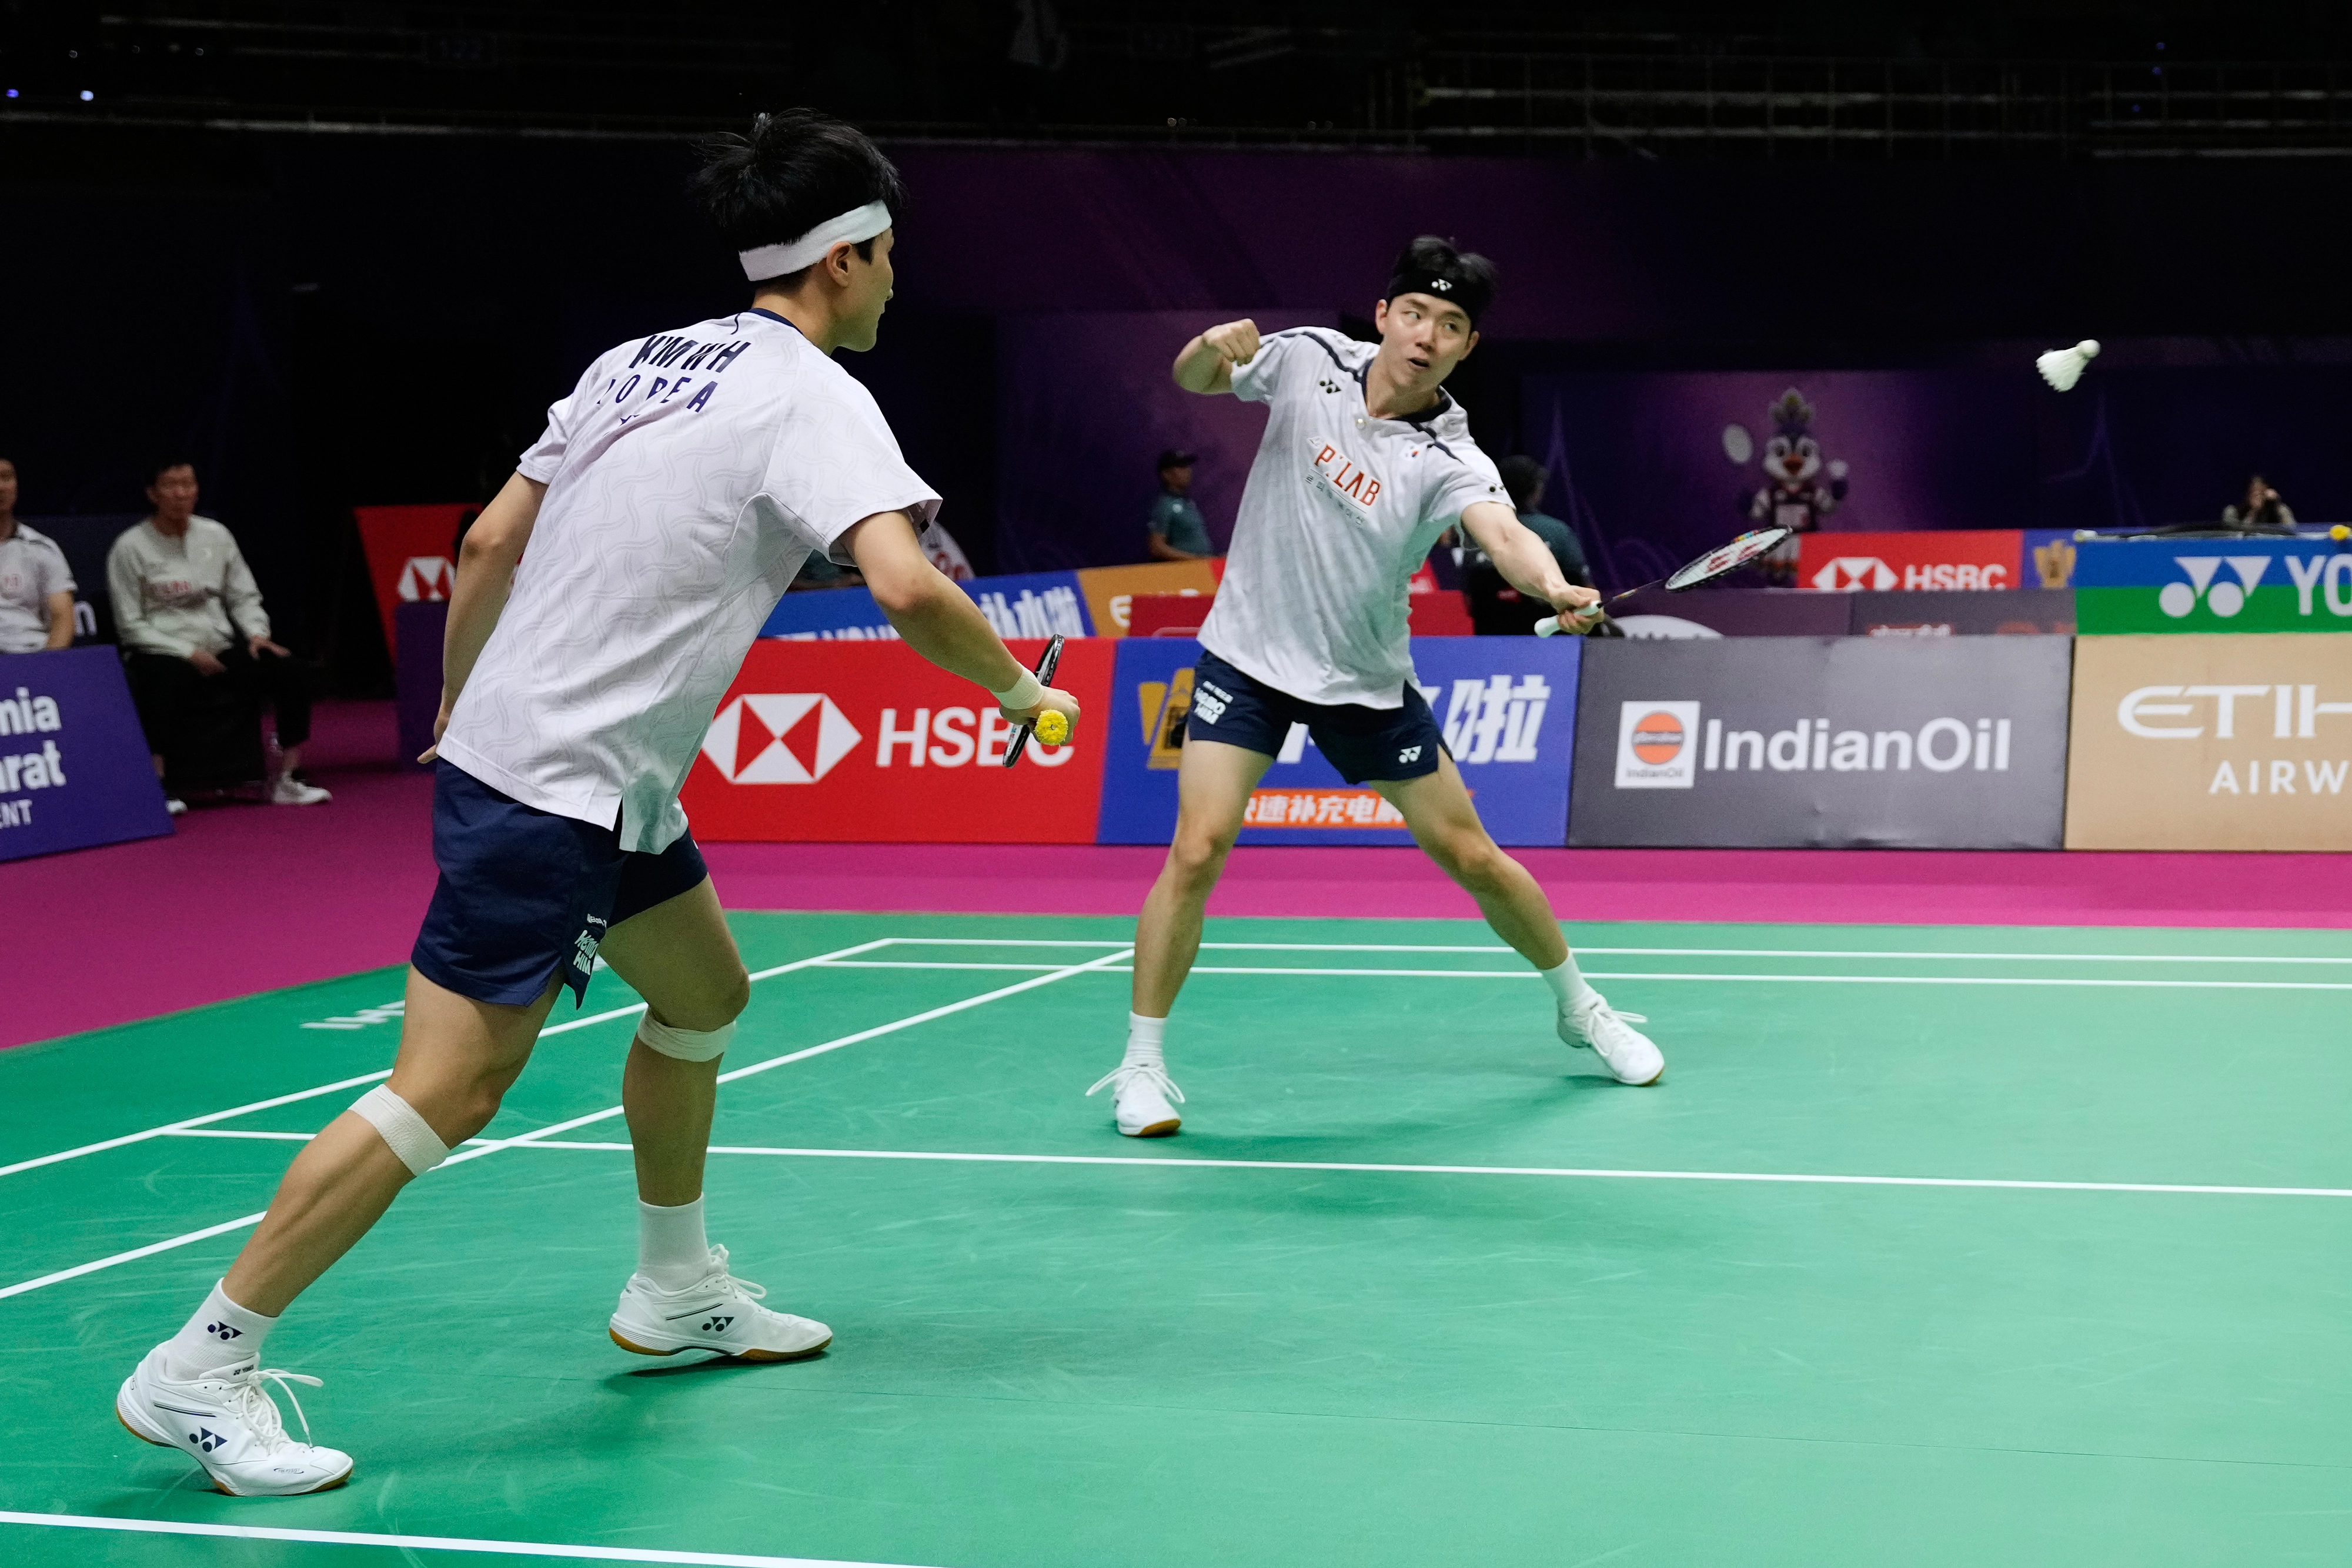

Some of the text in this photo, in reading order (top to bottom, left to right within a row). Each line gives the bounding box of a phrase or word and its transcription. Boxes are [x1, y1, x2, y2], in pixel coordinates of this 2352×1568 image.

[1906, 564, 2007, 591] HSBC
[2118, 684, 2352, 738] ETIH
[1704, 717, 2011, 771] IndianOil
[2209, 760, 2348, 794] AIRW
